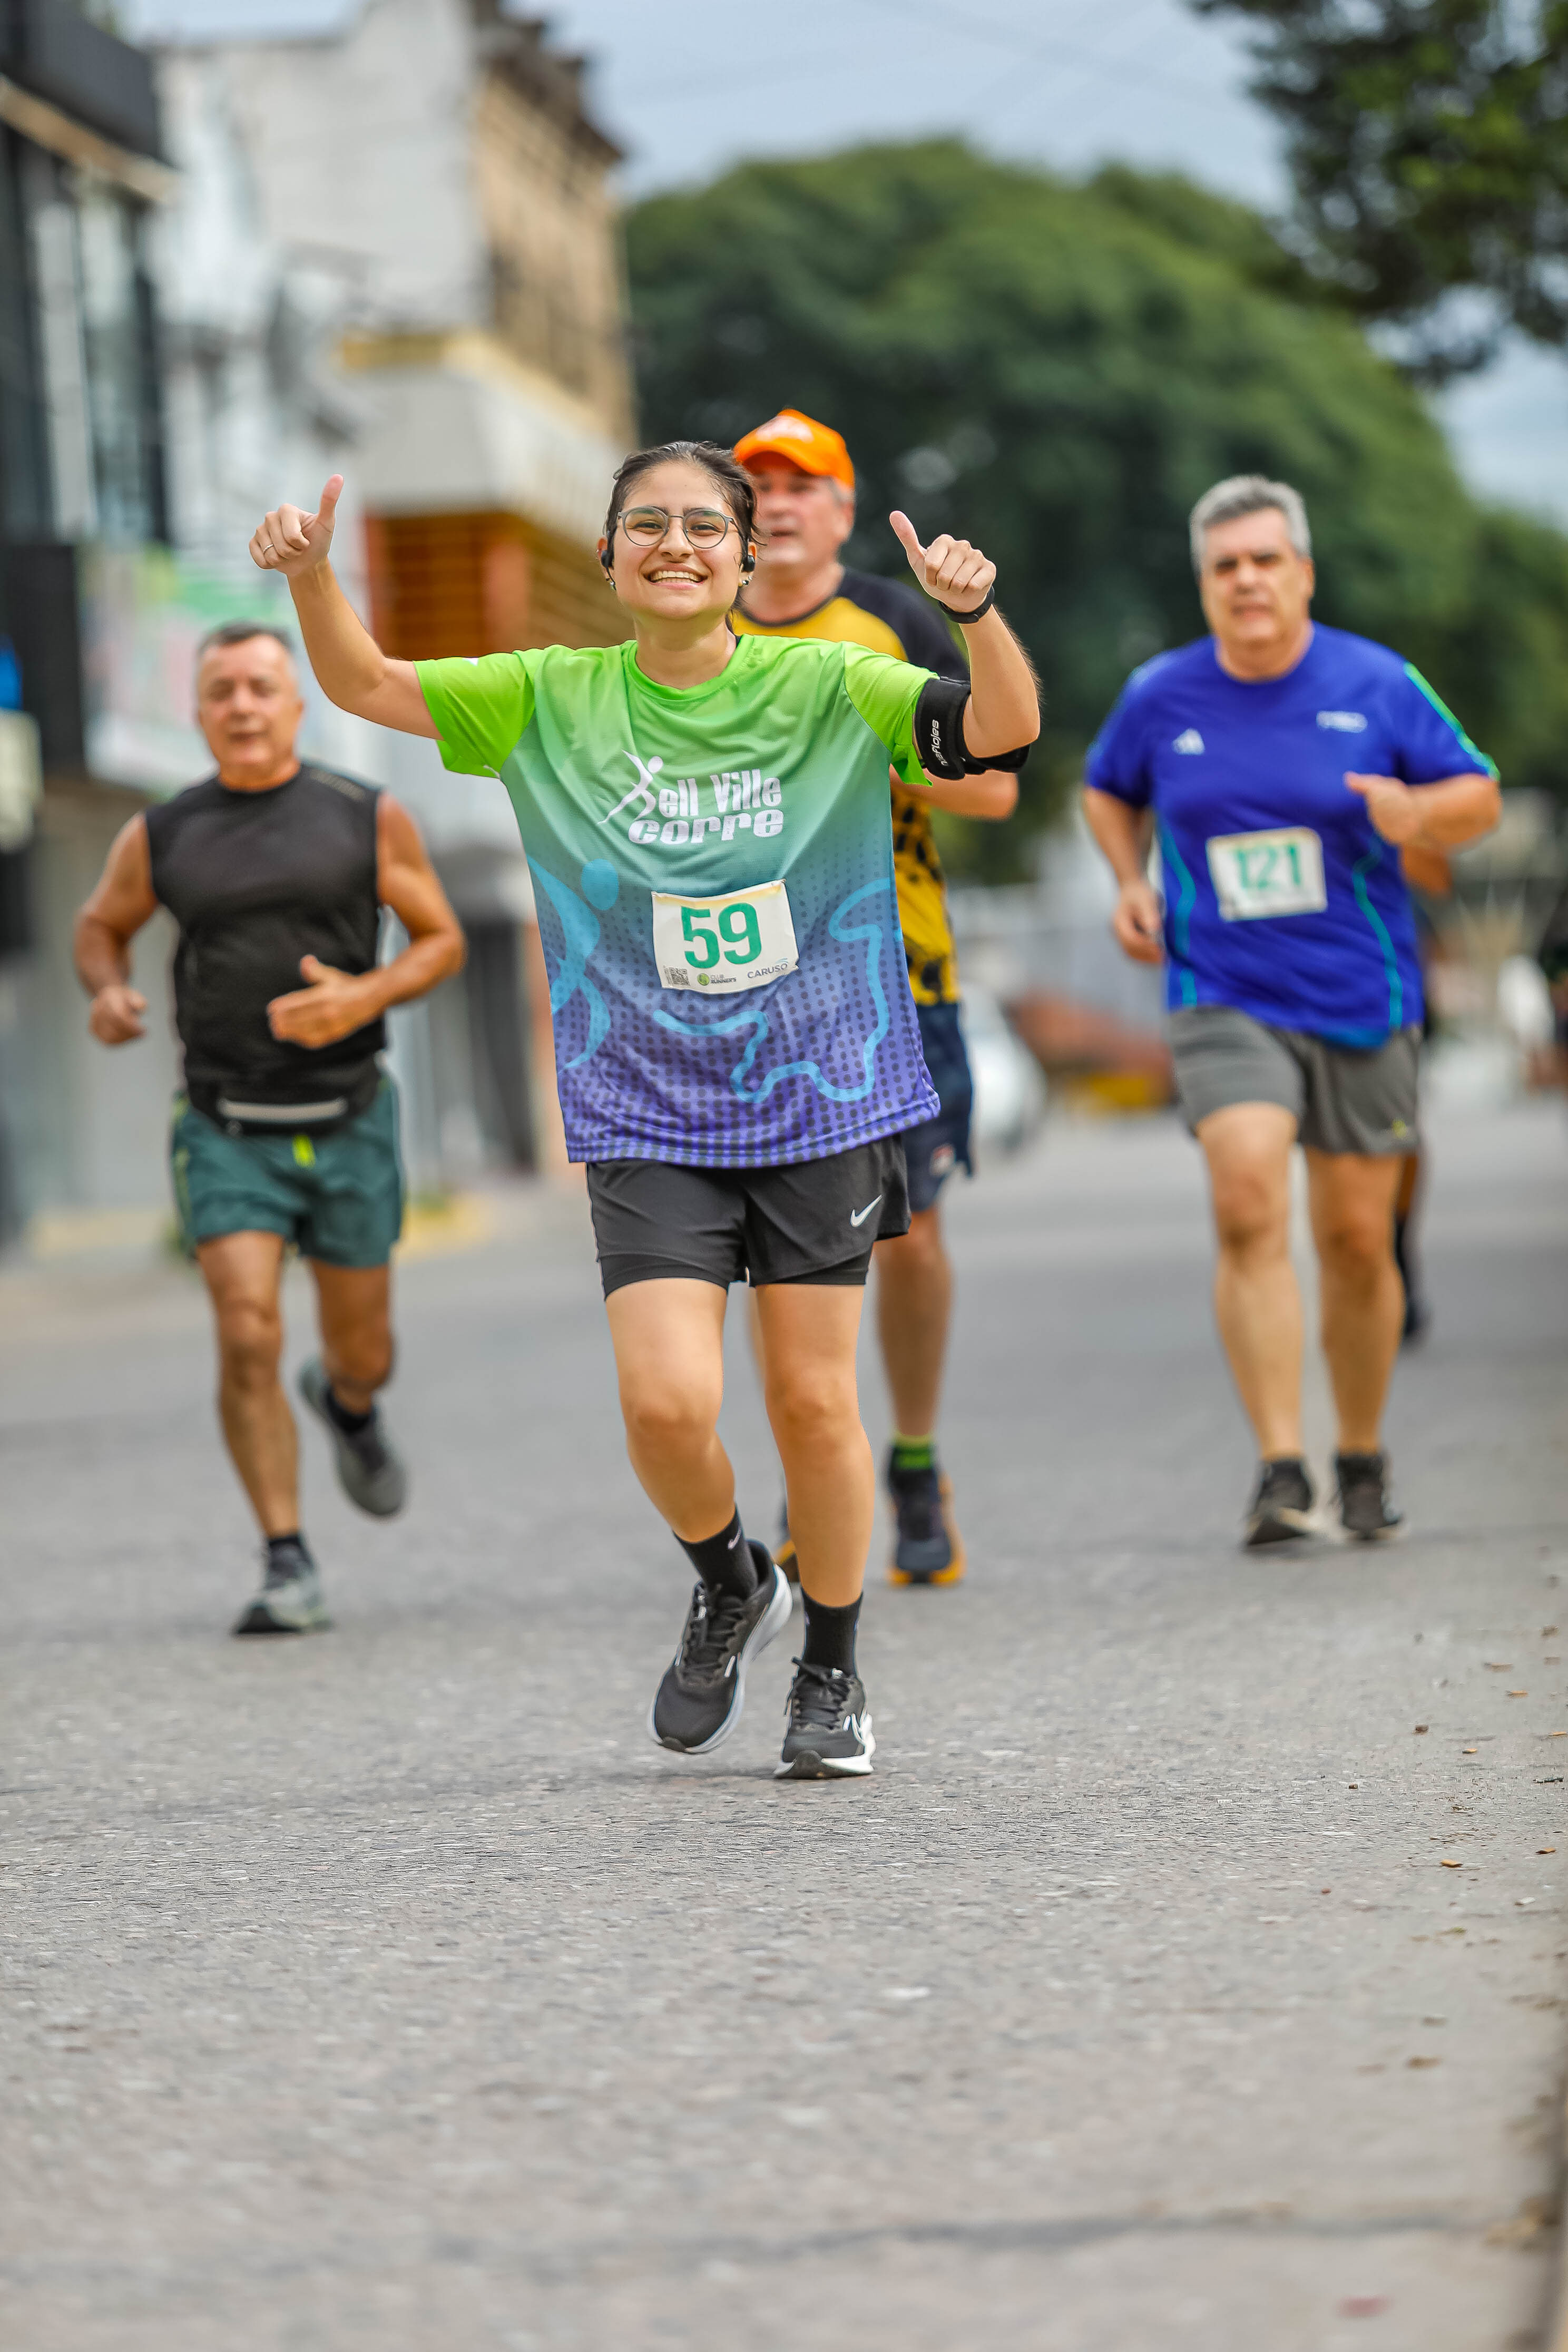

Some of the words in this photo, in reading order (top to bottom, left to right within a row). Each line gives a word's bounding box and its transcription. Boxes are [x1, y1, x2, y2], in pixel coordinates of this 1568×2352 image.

[710, 769, 782, 812] Ville
[628, 809, 784, 844] corre
[1231, 839, 1302, 890] 121
[681, 903, 762, 969] 59
[747, 963, 788, 978] CARUSO
